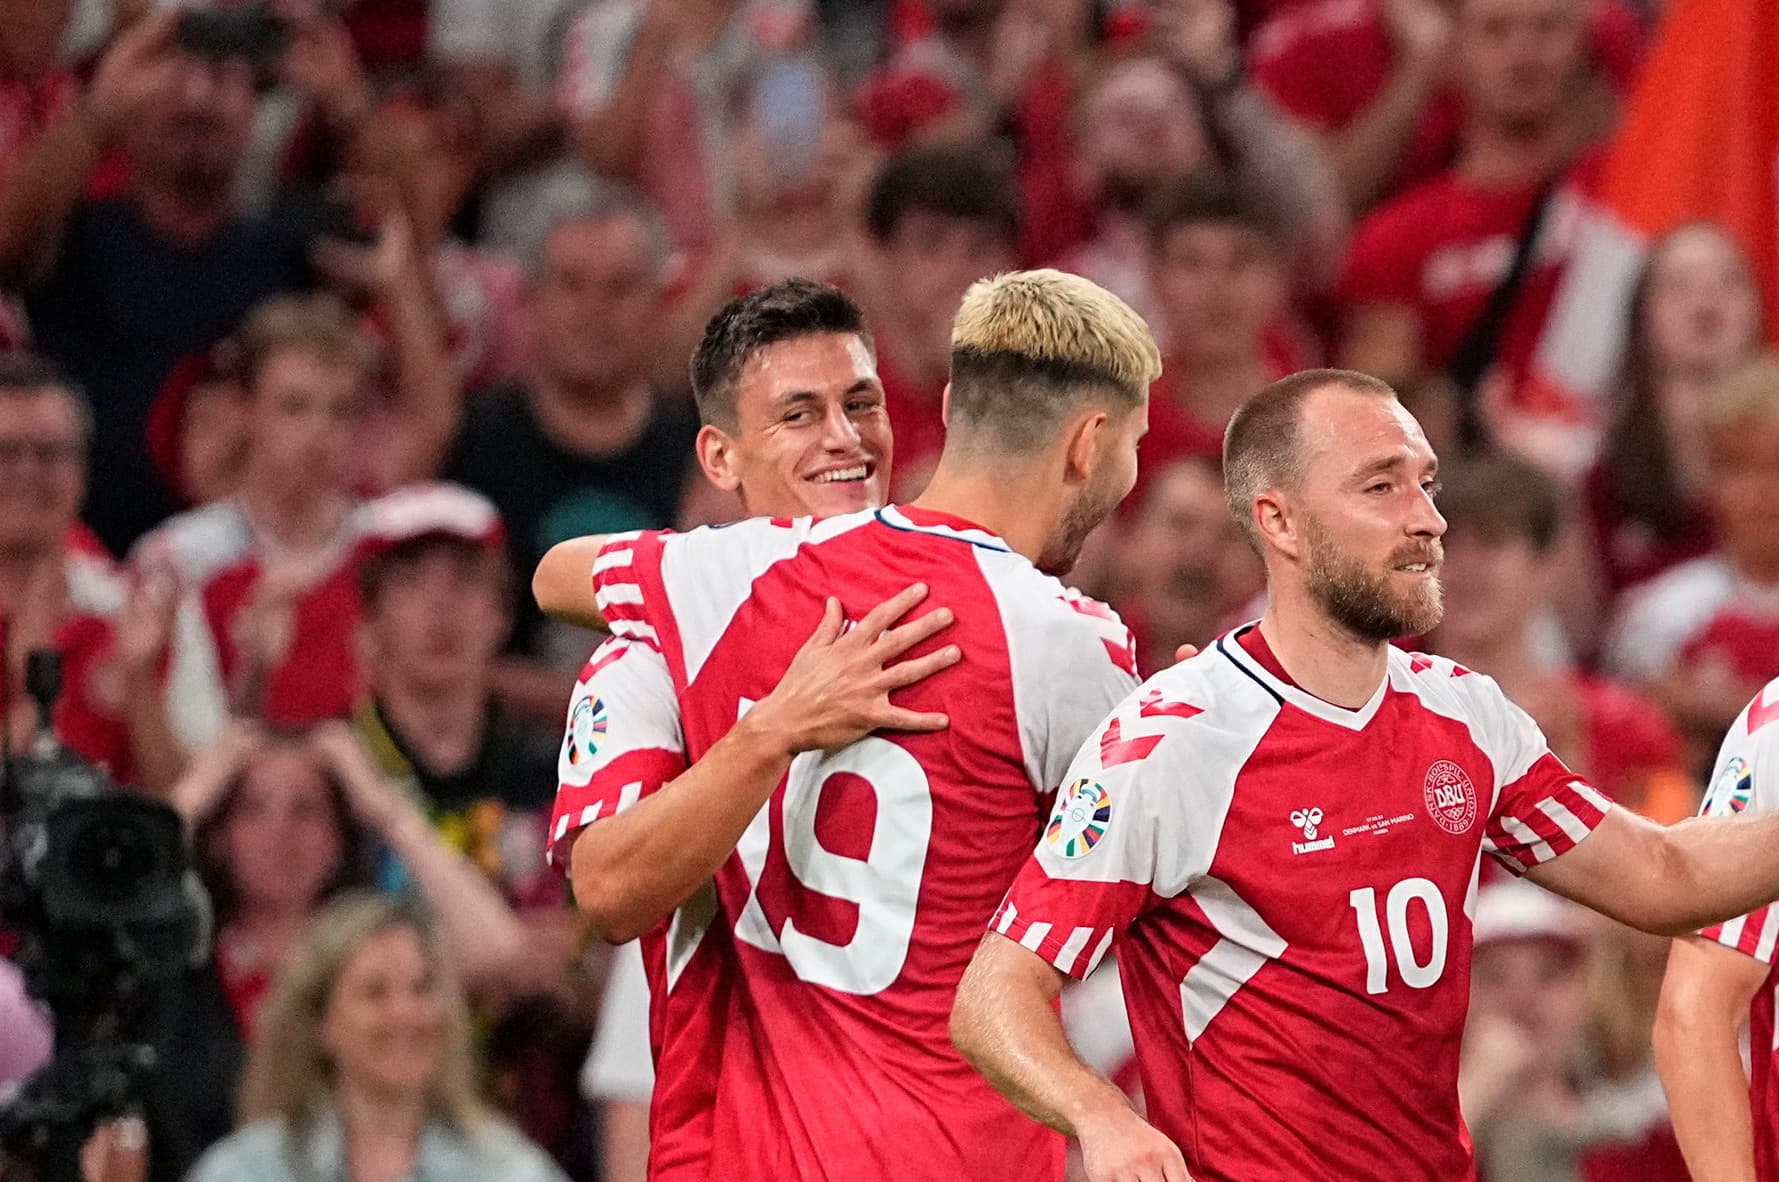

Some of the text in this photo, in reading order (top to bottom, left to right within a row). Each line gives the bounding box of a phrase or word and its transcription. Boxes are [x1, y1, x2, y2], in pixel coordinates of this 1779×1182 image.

[1434, 784, 1466, 808] DBU
[1292, 834, 1336, 855] hummel
[1349, 877, 1449, 995] 10
